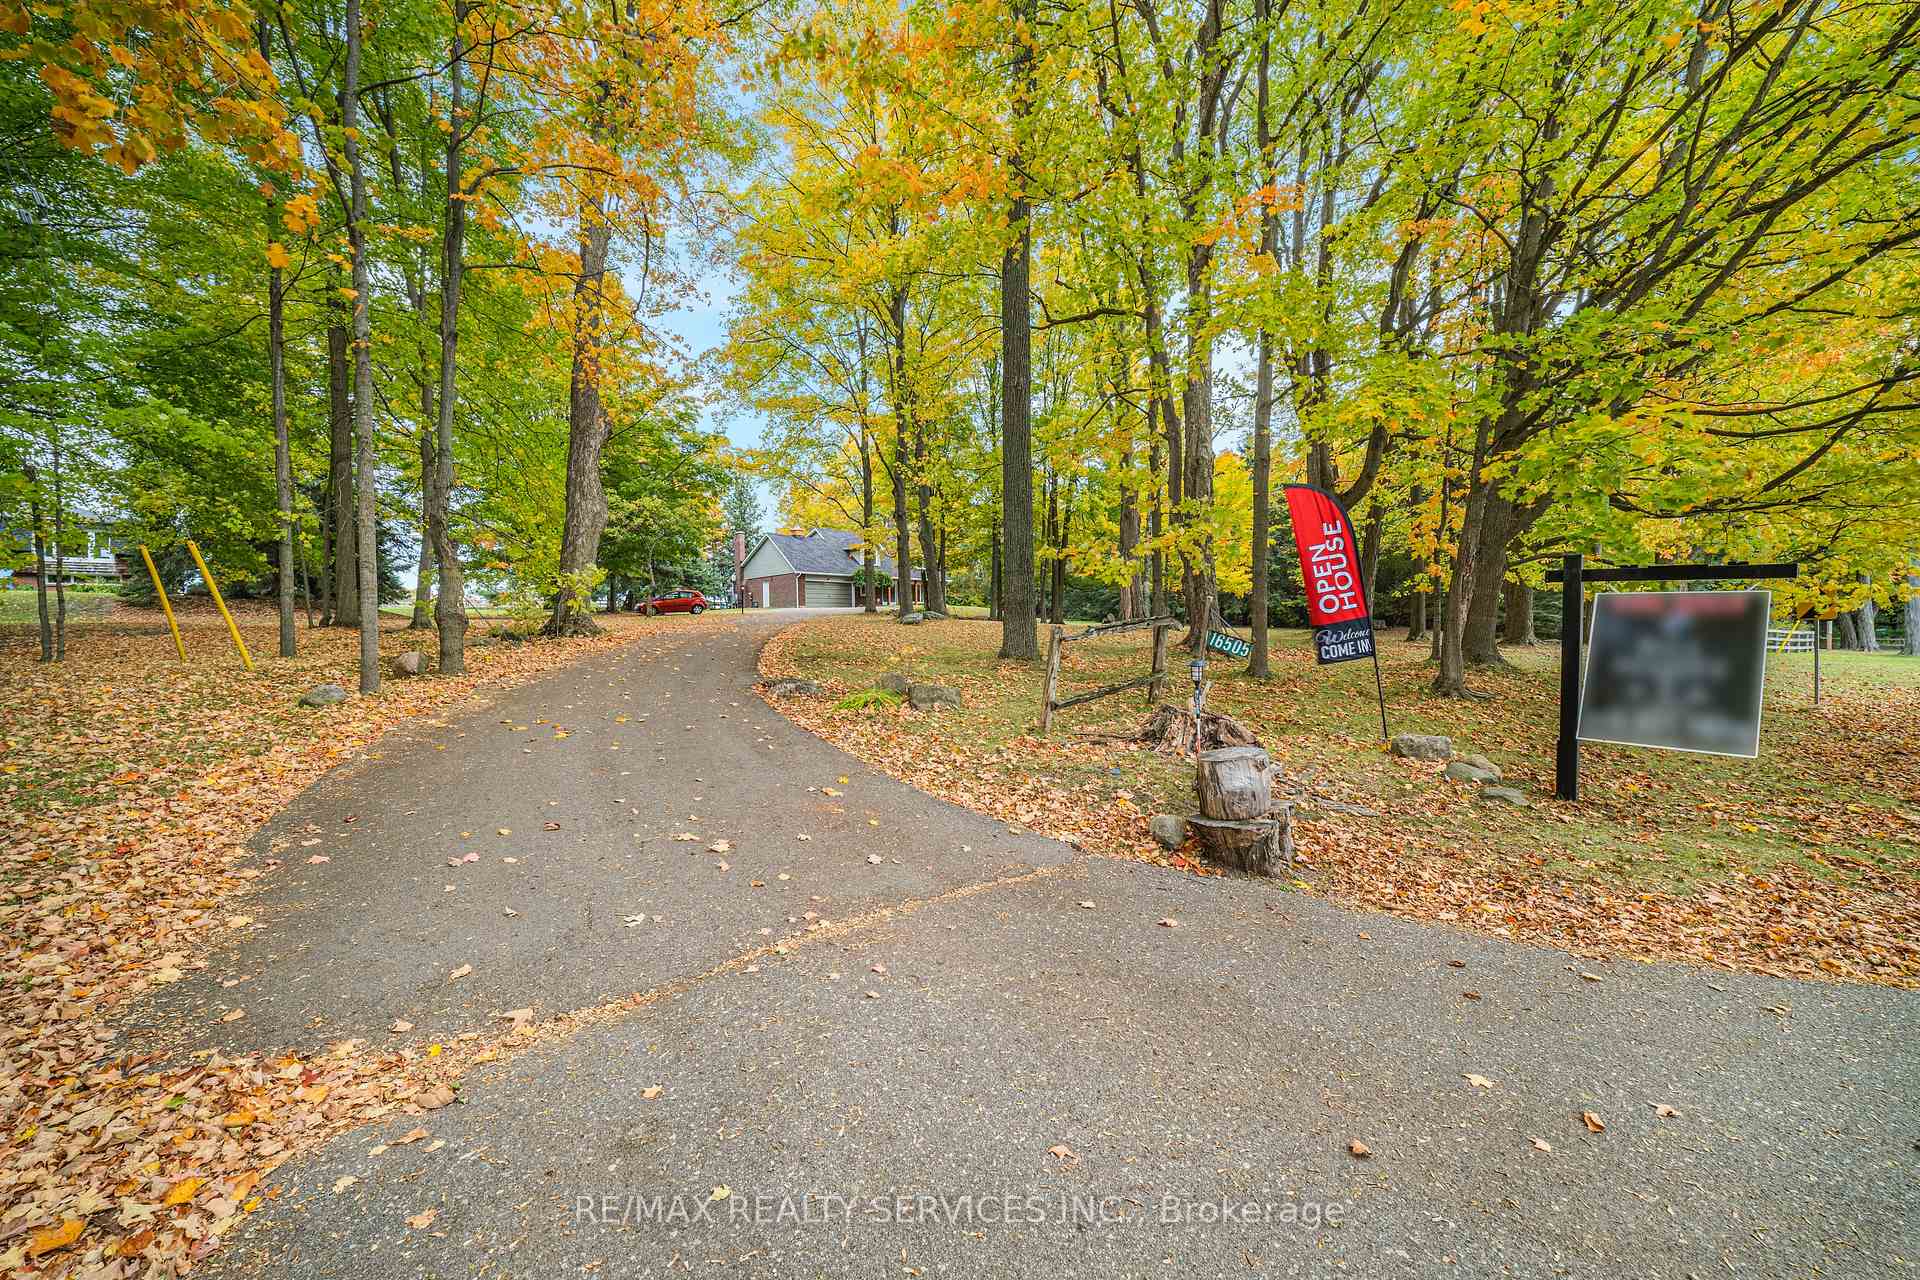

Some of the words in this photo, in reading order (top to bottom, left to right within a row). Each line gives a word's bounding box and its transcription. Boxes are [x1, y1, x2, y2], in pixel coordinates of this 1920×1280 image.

[1322, 519, 1358, 610] HOUSE
[1310, 544, 1340, 614] OPEN
[1209, 633, 1250, 657] 16505
[1316, 629, 1370, 645] Welcome
[1321, 640, 1356, 659] COME
[1357, 636, 1372, 653] IN!
